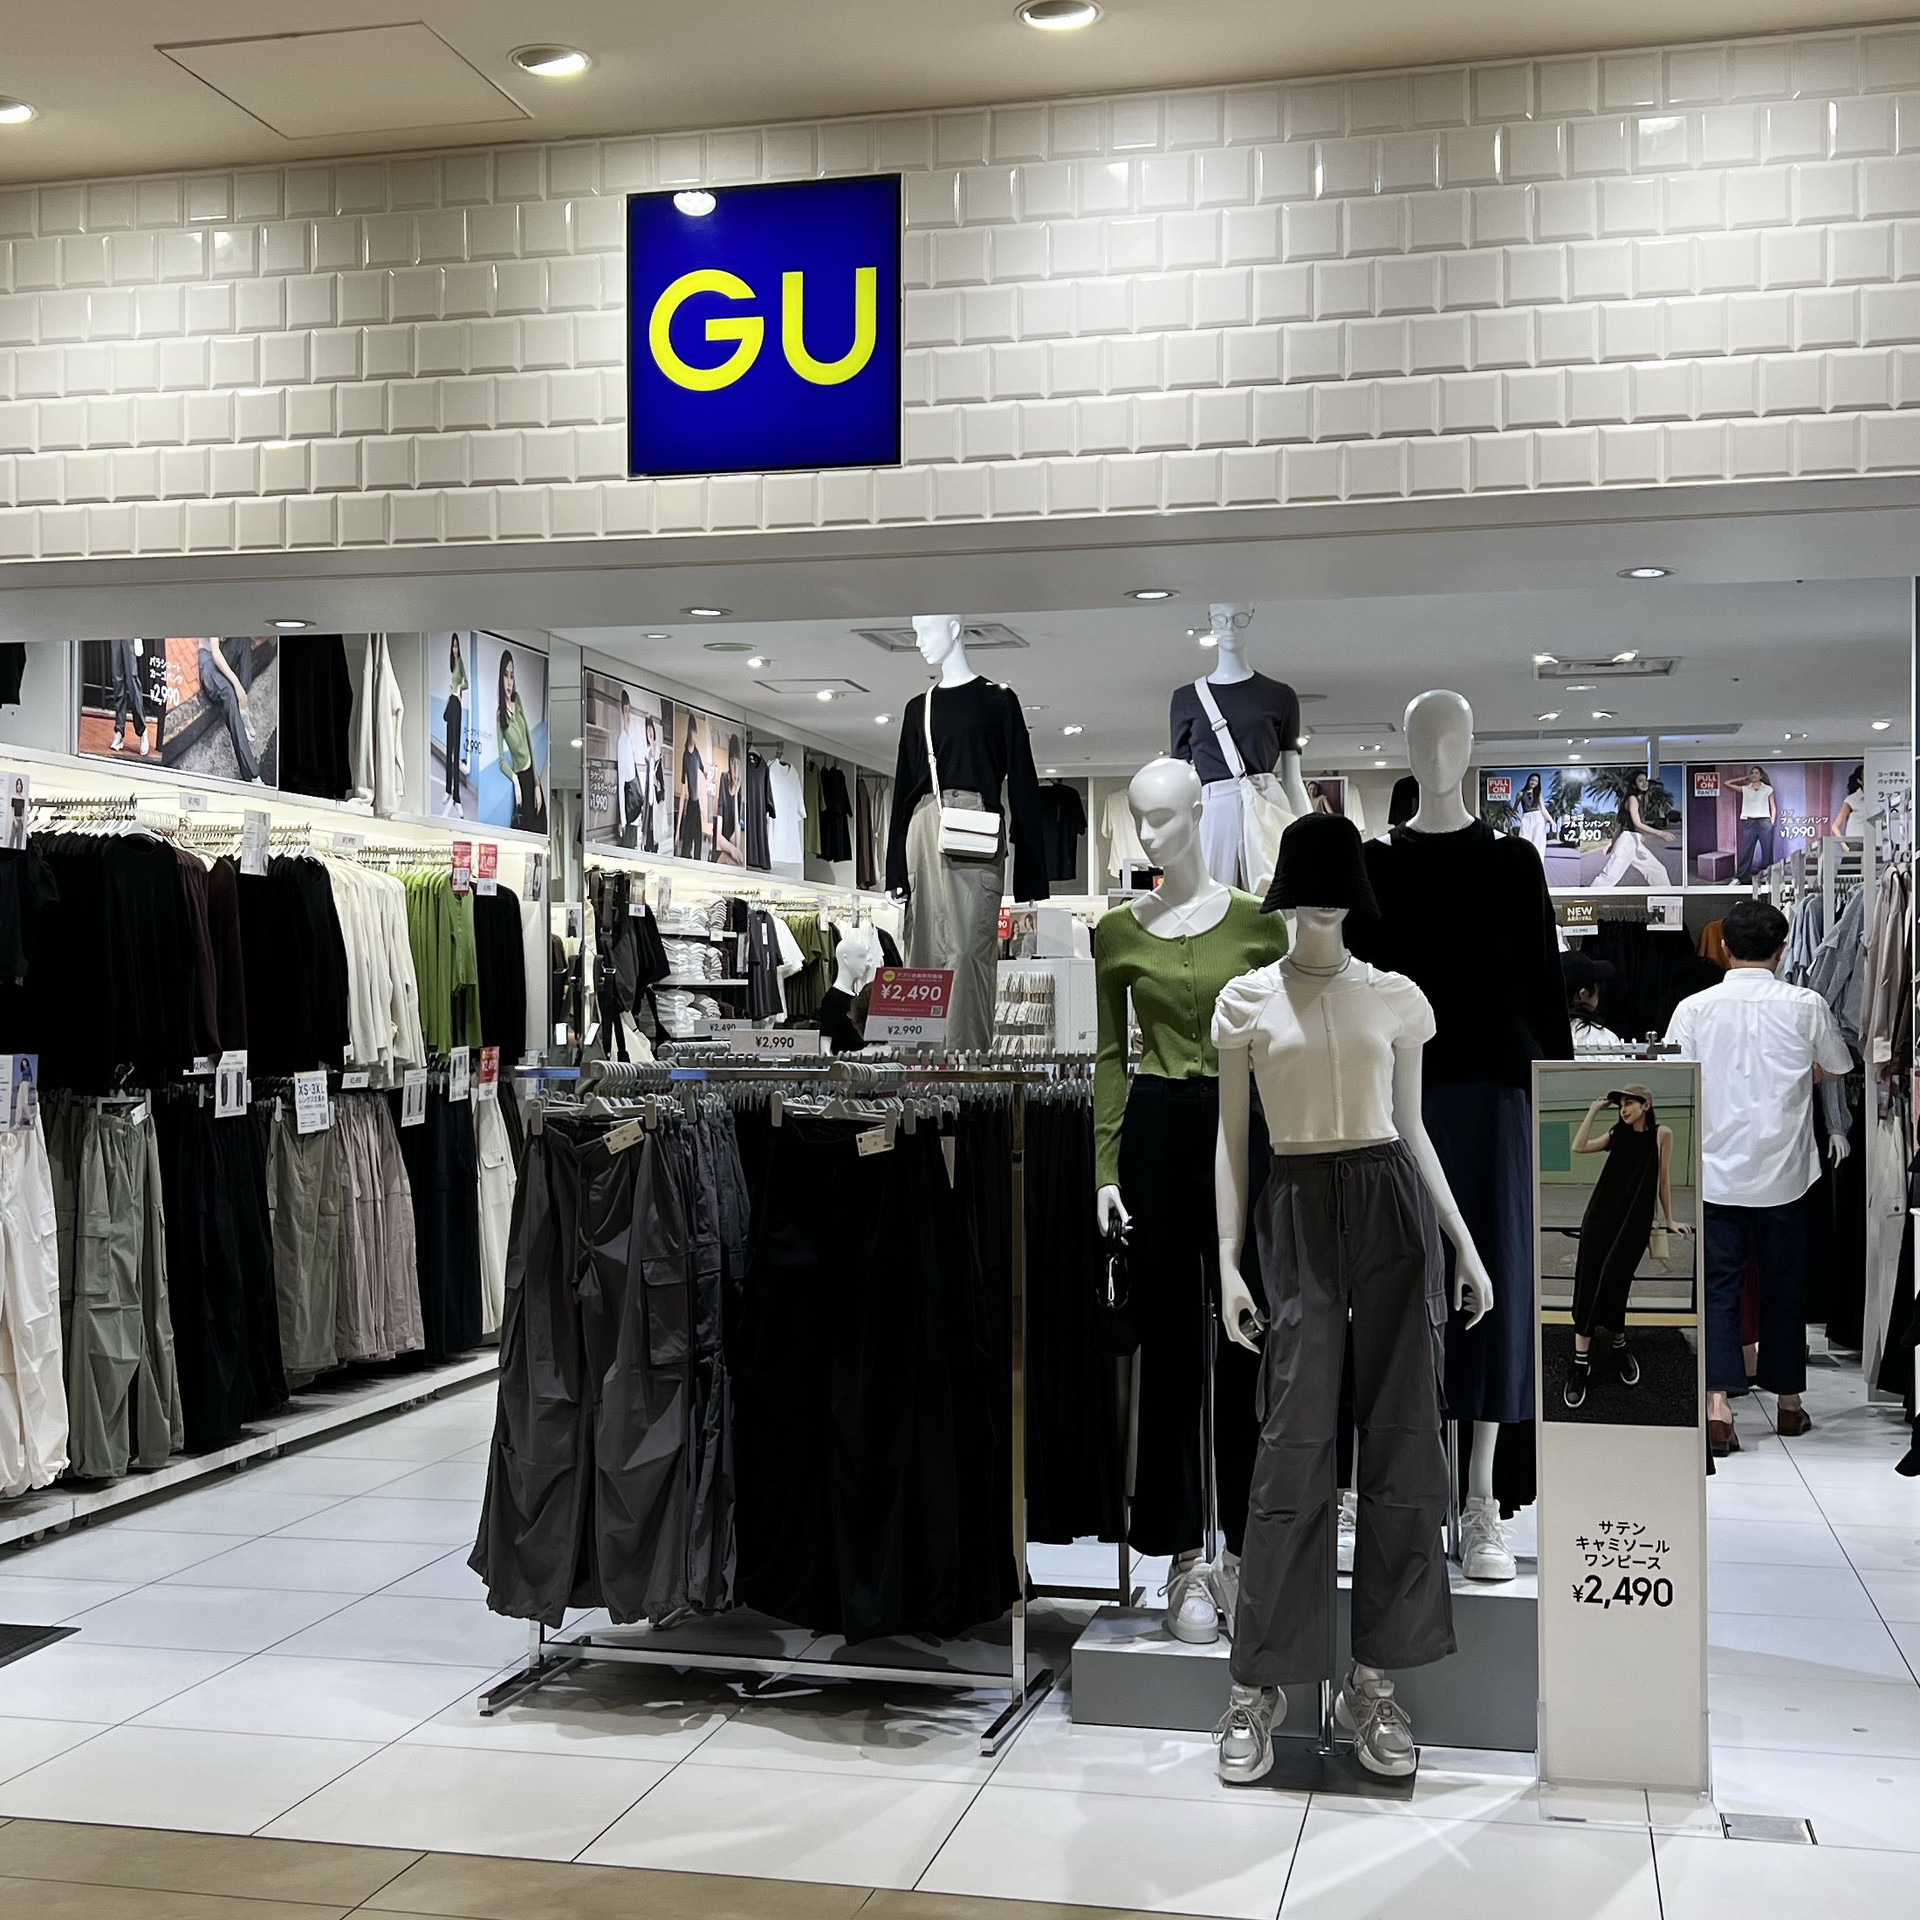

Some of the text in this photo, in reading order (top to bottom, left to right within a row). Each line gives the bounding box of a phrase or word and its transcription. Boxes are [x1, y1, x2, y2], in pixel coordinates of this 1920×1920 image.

[649, 267, 877, 391] GU
[149, 684, 180, 706] ¥2,990
[1490, 779, 1508, 787] PULL
[1697, 774, 1716, 782] PULL
[1701, 781, 1714, 789] ON
[1563, 829, 1602, 843] ¥2,490
[1780, 826, 1815, 839] ¥1,990
[1567, 906, 1593, 917] NEW
[881, 984, 942, 1001] ¥2,490
[887, 1025, 923, 1036] ¥2,990
[755, 1036, 795, 1048] ¥2,990
[1598, 1520, 1646, 1536] サテン
[1575, 1536, 1670, 1553] キャミソール
[1584, 1554, 1661, 1570] ワンピース
[1572, 1574, 1673, 1609] ¥2,490
